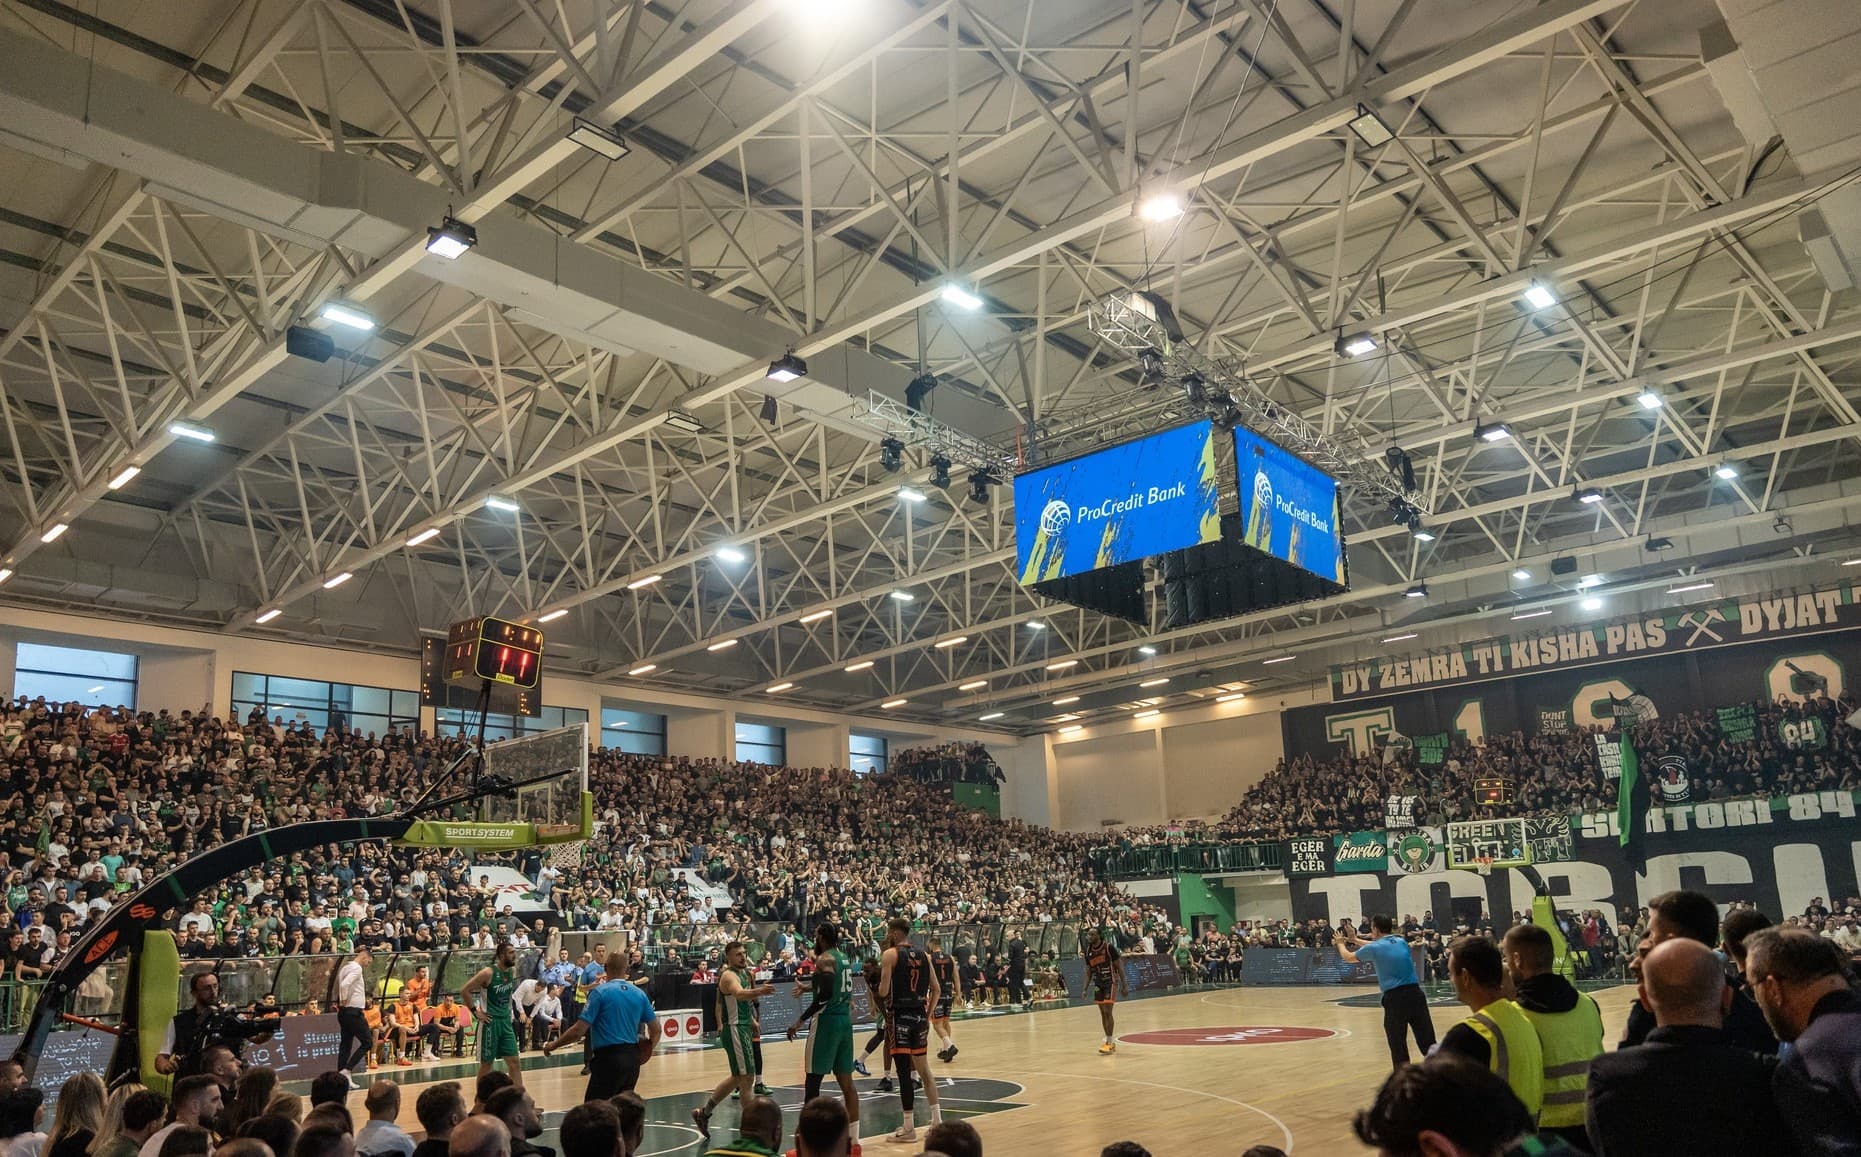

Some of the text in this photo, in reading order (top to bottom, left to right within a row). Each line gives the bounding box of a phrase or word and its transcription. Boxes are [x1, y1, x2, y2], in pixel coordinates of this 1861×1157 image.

[1077, 480, 1186, 524] ProCredit Bank
[1275, 495, 1329, 535] ProCredit Bank
[1341, 668, 1372, 695] DY
[1378, 651, 1468, 689] ZEMRA
[1473, 645, 1504, 674] TI
[1509, 629, 1600, 669] KISHA
[1605, 618, 1667, 655] PAS
[1787, 791, 1856, 821] 84
[1305, 852, 1319, 860] MA
[1336, 840, 1385, 863] Garda
[840, 968, 853, 992] 15
